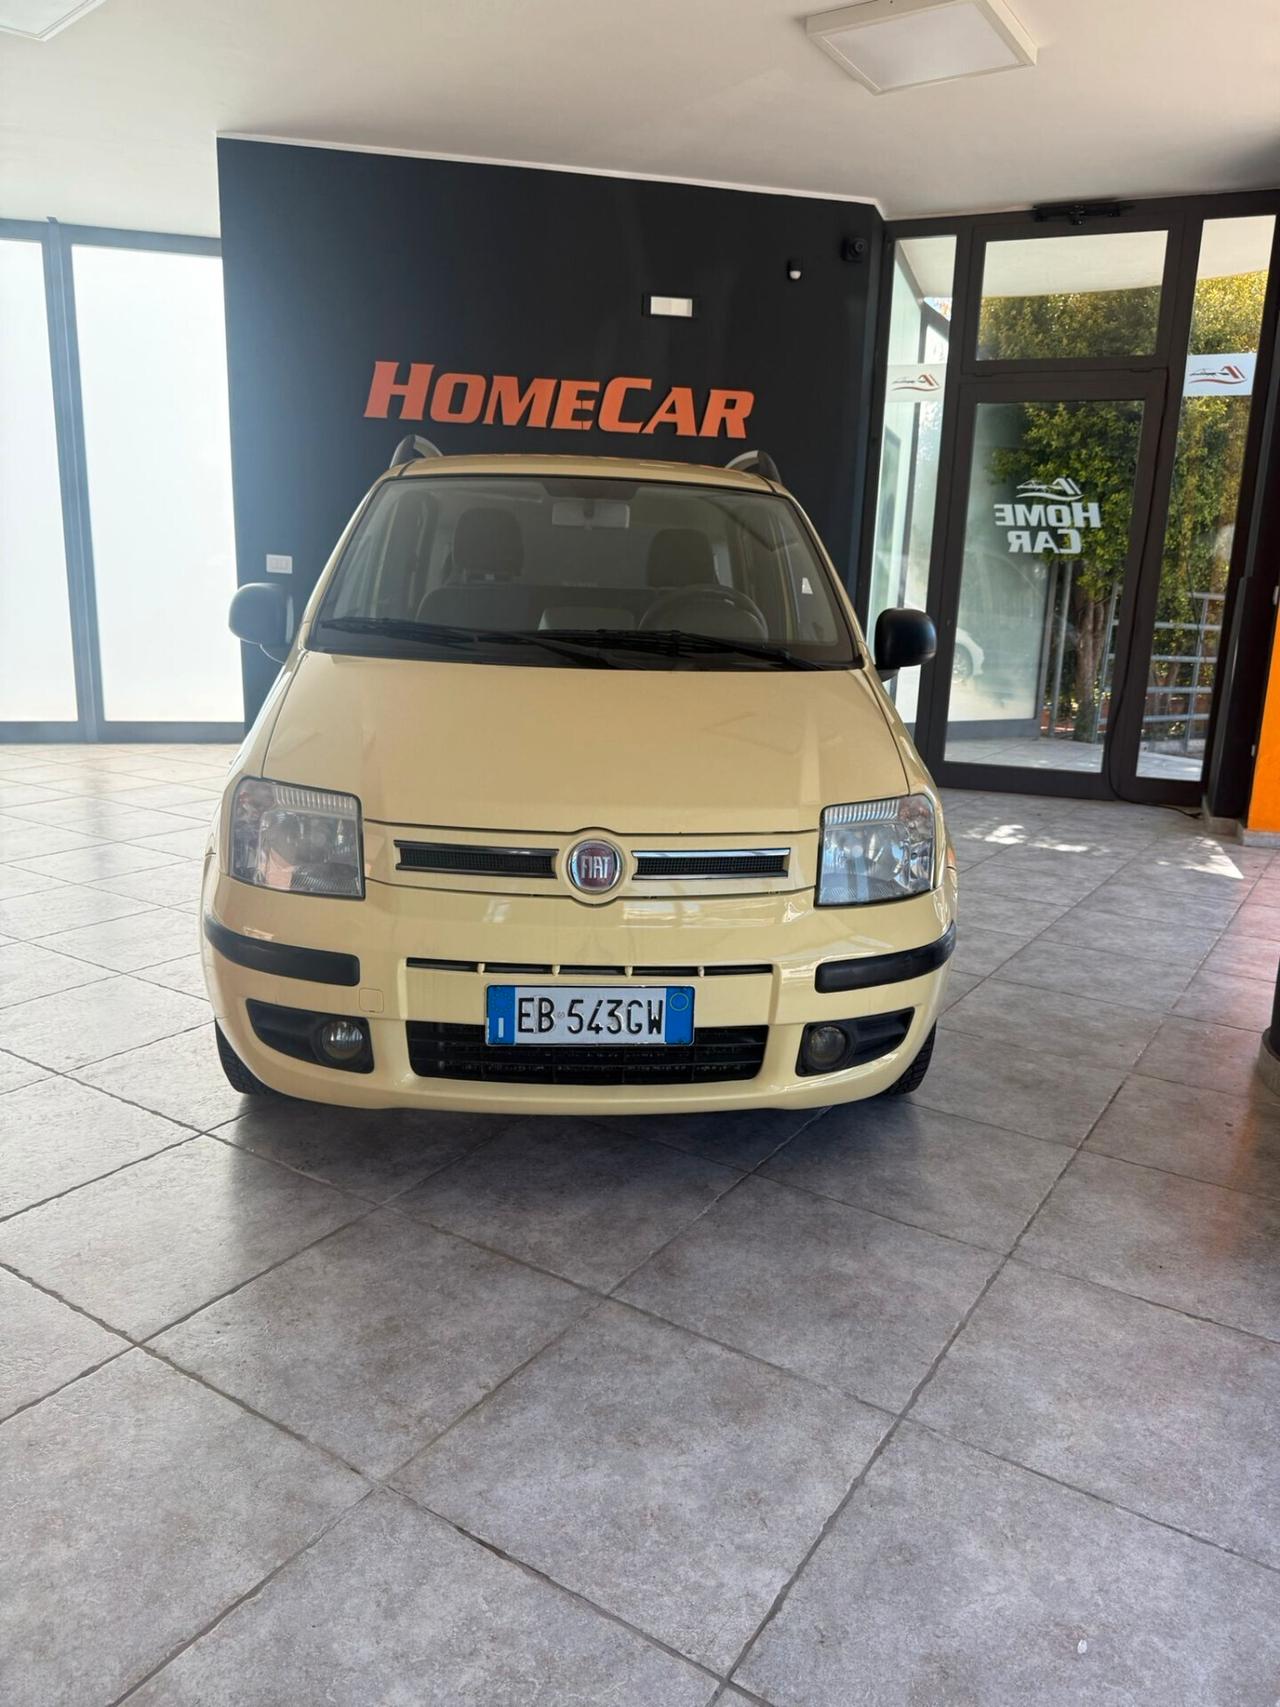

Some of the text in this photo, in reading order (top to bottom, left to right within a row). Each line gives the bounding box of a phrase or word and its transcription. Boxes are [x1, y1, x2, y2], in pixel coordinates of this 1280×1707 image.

[581, 855, 611, 879] FIAT
[517, 997, 664, 1034] EB 543GW
